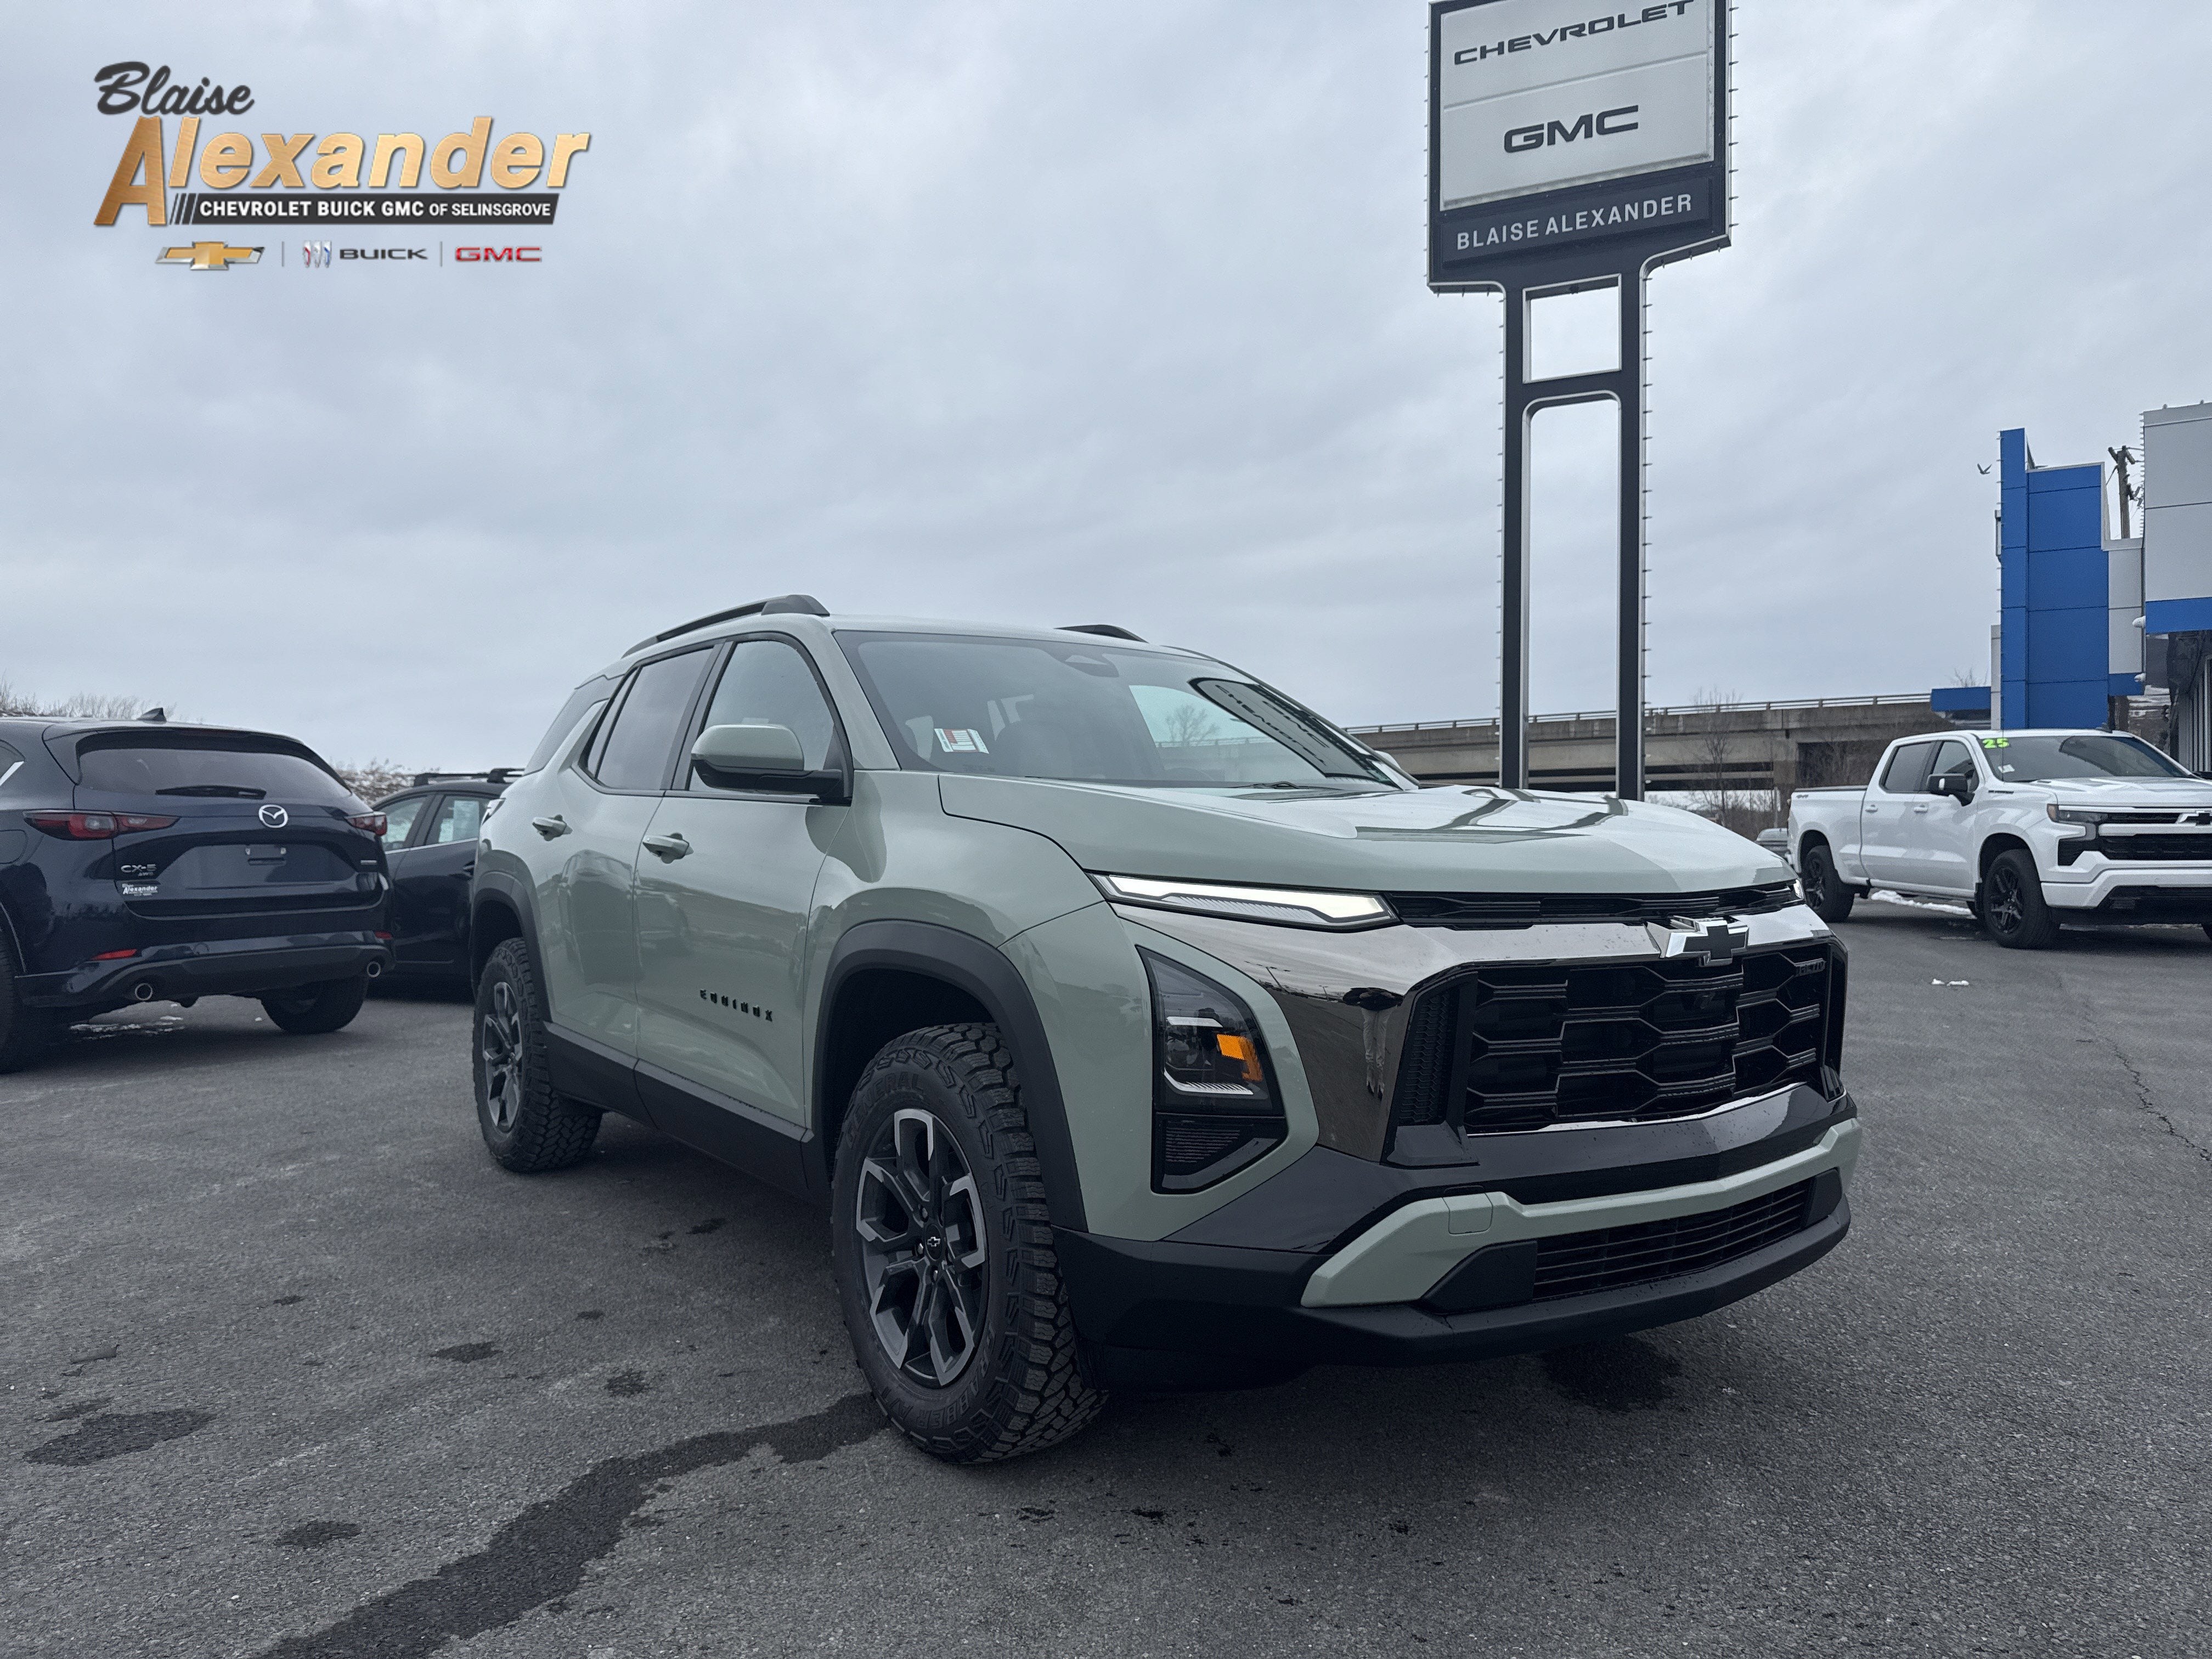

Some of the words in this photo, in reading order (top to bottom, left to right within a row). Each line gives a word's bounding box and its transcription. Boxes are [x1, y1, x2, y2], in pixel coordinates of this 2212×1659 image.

[1454, 0, 1694, 65] CHEVROLET
[1504, 105, 1639, 154] GMC
[1457, 219, 1539, 250] BLAISE
[1545, 193, 1692, 235] ALEXANDER
[1982, 738, 2010, 749] 25
[121, 864, 156, 873] CX-5
